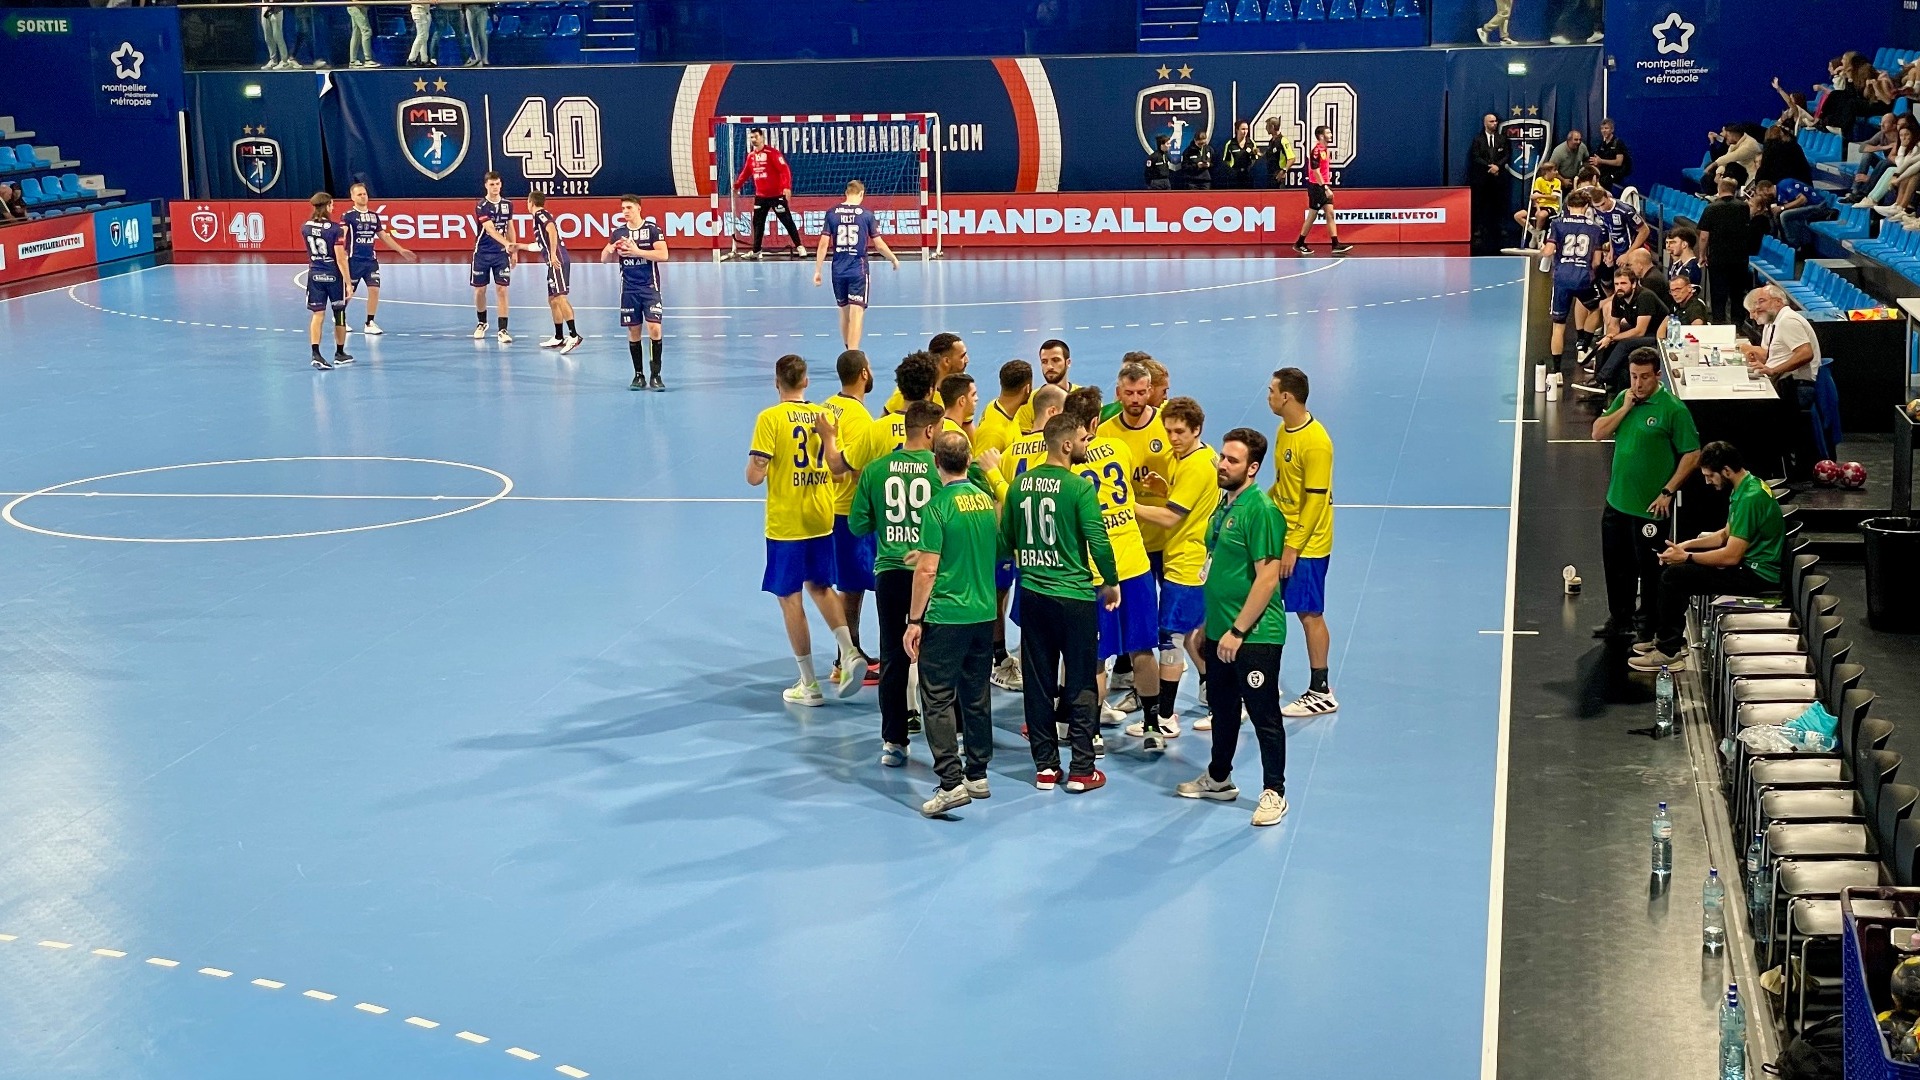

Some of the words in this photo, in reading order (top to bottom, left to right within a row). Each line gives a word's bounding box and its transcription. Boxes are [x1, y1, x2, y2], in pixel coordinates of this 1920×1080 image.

[17, 19, 68, 32] SORTIE
[1150, 96, 1202, 111] MHB
[409, 109, 458, 122] MHB
[1250, 82, 1358, 169] 40
[1507, 127, 1544, 138] MHB
[502, 96, 603, 178] 40
[241, 146, 274, 154] MHB
[124, 218, 139, 244] 40
[228, 212, 265, 243] 40
[836, 224, 860, 246] 25
[1562, 233, 1590, 257] 23
[892, 423, 905, 437] PE
[889, 461, 928, 474] MARTINS
[793, 472, 828, 487] BRASIL
[1020, 477, 1033, 492] DA
[1034, 477, 1062, 494] ROSA
[1080, 461, 1128, 511] 23
[884, 475, 932, 525] 99
[954, 494, 994, 512] BRASIL
[1019, 496, 1057, 546] 16
[886, 526, 920, 543] BRAS
[1021, 549, 1064, 567] BRASIL
